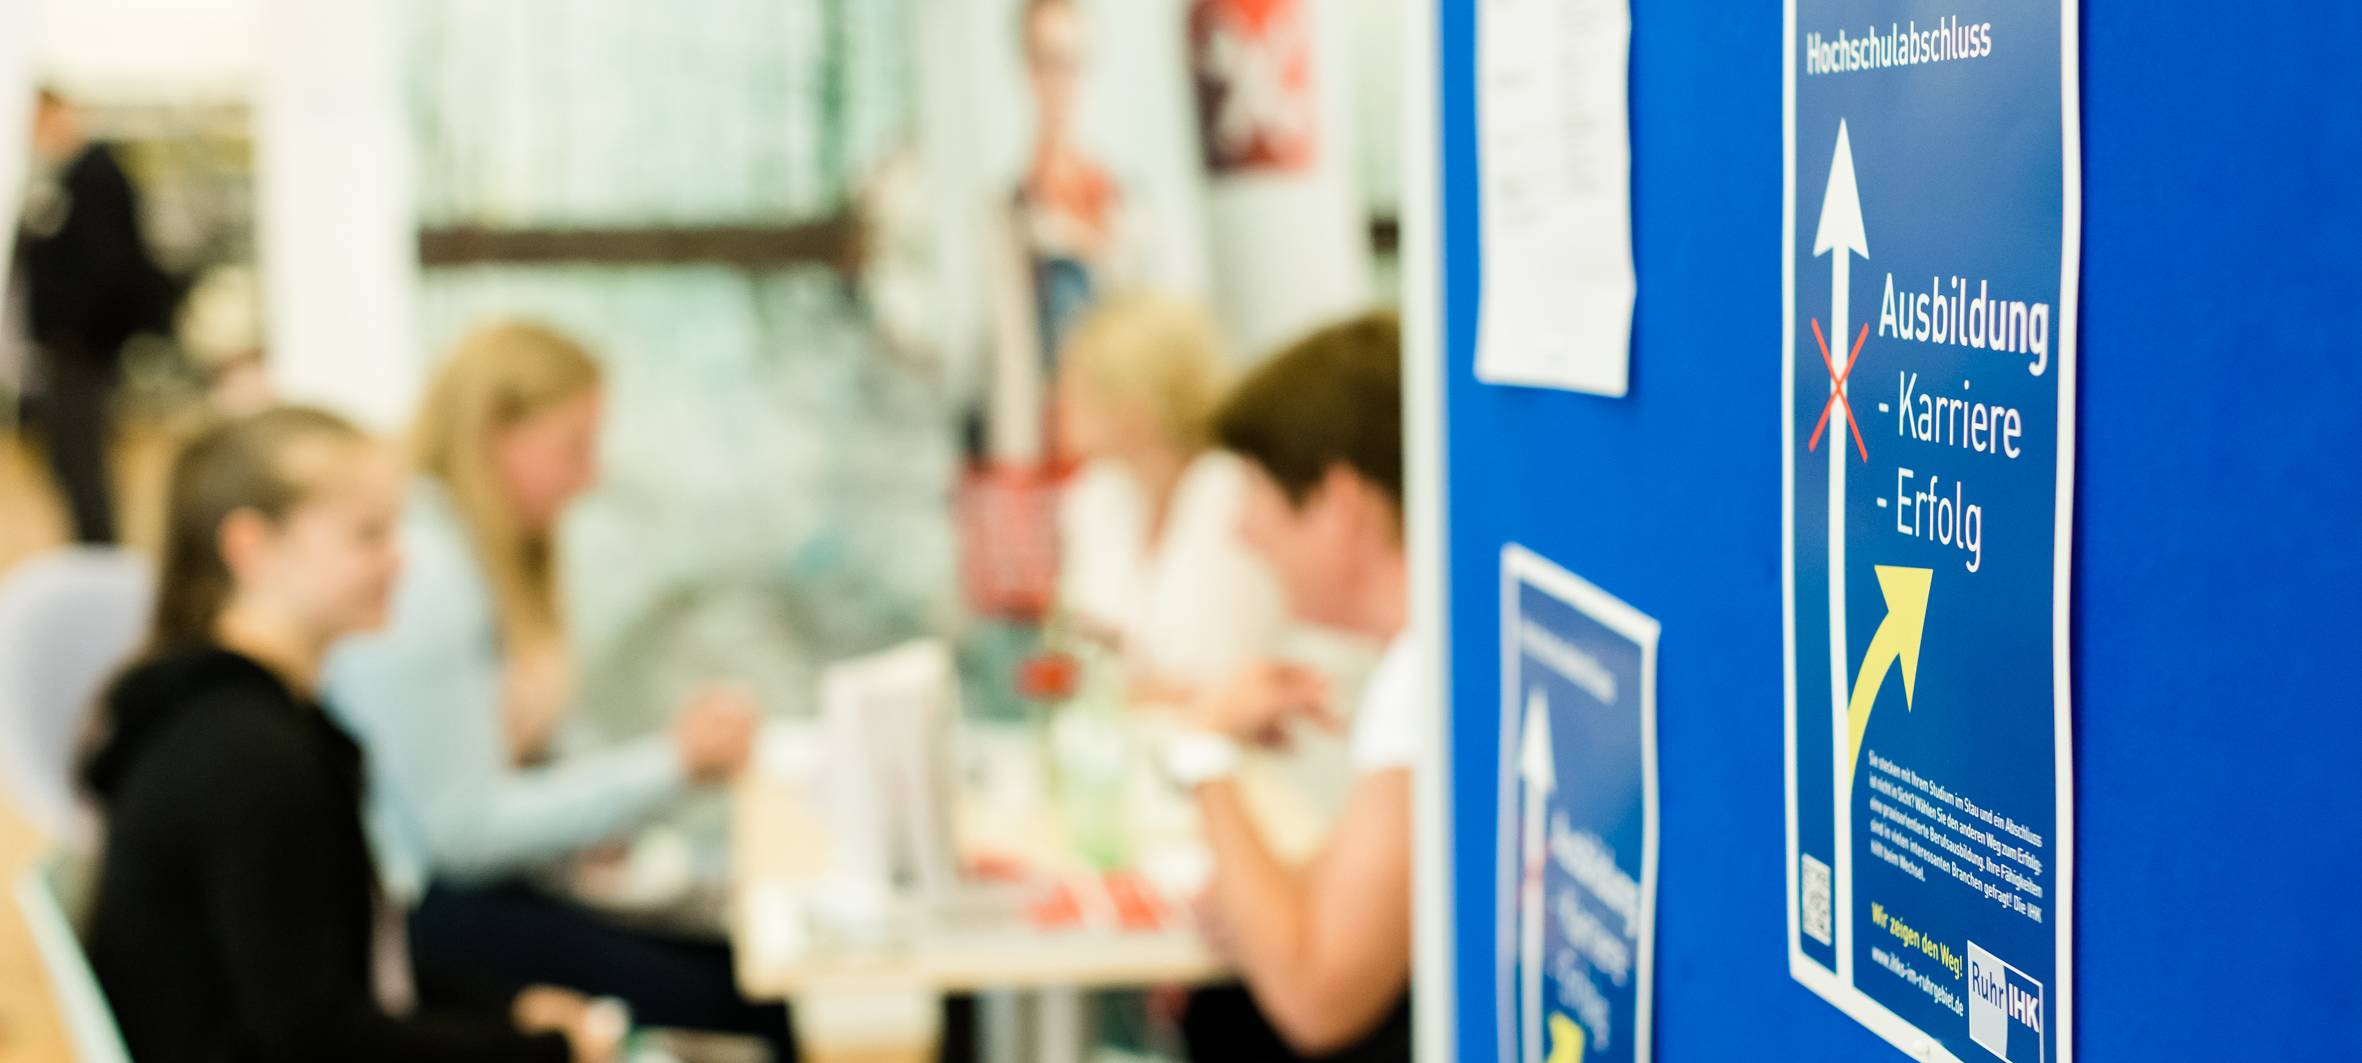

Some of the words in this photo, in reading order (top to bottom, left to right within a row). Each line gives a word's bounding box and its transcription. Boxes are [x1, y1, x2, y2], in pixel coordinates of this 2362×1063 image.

[1806, 15, 1992, 75] Hochschulabschluss
[1878, 272, 2050, 376] Ausbildung
[1878, 402, 1889, 413] -
[1898, 370, 2022, 459] Karriere
[1876, 496, 1887, 508] -
[1896, 467, 1982, 573] Erfolg
[1911, 770, 1929, 792] Ihrem
[1929, 779, 1954, 805] Studium
[1955, 792, 1964, 810] im
[1964, 797, 1979, 817] Stau
[1979, 809, 1993, 824] und
[1993, 812, 2005, 830] ein
[2005, 816, 2043, 848] Abschluss
[1914, 795, 1937, 820] Wählen
[1937, 807, 1947, 825] Sie
[1947, 813, 1959, 831] den
[1959, 822, 1986, 846] anderen
[1986, 831, 2001, 857] Weg
[2001, 843, 2017, 861] zum
[1909, 836, 1950, 874] interessanten
[1951, 861, 1983, 893] Branchen
[1983, 883, 2012, 909] gefragt!
[2013, 894, 2026, 915] Die
[2026, 902, 2042, 924] IHK
[1929, 825, 1985, 872] Berufsausbildung.
[1986, 856, 2000, 877] Ihre
[2000, 863, 2043, 899] Fähigkeiten
[1872, 901, 1889, 929] Wir
[1890, 916, 1920, 949] zeigen
[1922, 931, 1939, 961] den
[1940, 941, 1963, 981] Weg!
